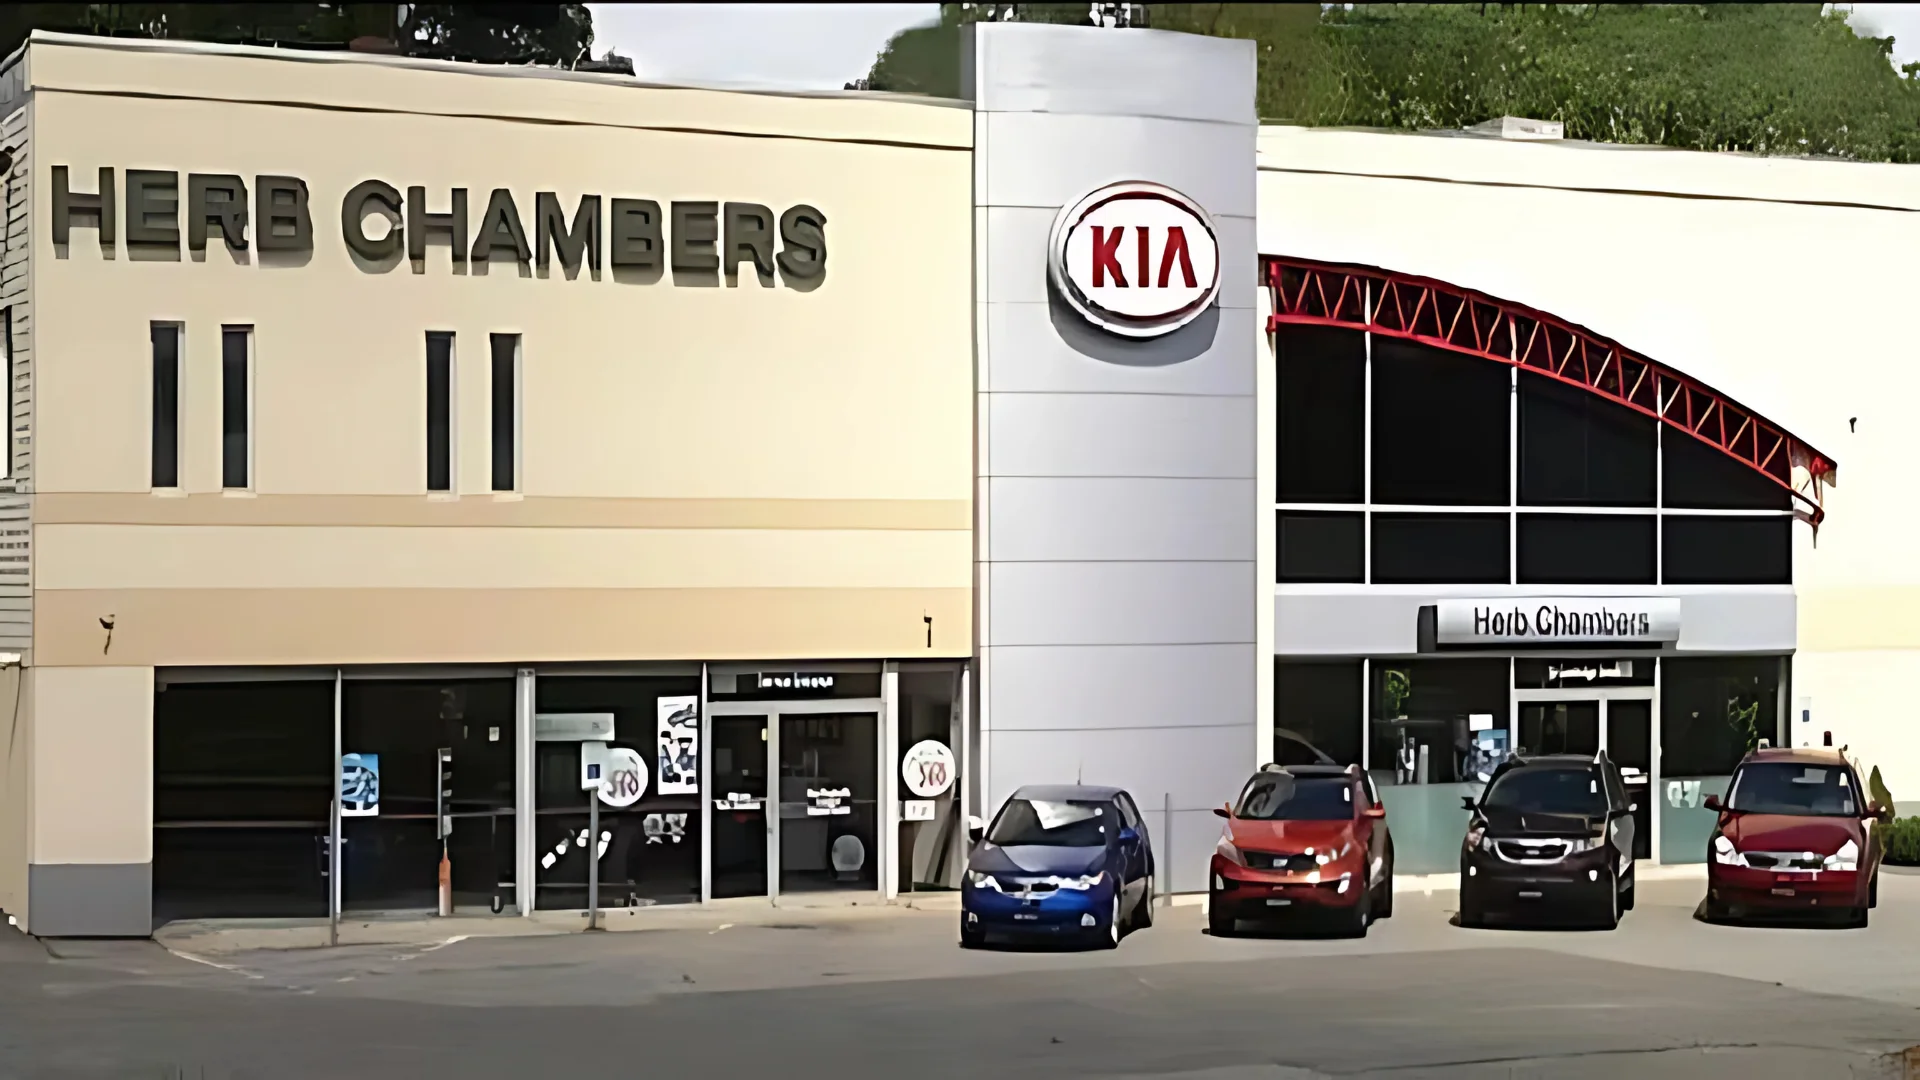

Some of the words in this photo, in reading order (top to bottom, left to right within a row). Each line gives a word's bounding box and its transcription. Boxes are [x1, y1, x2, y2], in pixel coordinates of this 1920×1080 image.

[51, 165, 313, 258] HERB
[342, 179, 827, 282] CHAMBERS
[1090, 226, 1198, 288] KIA
